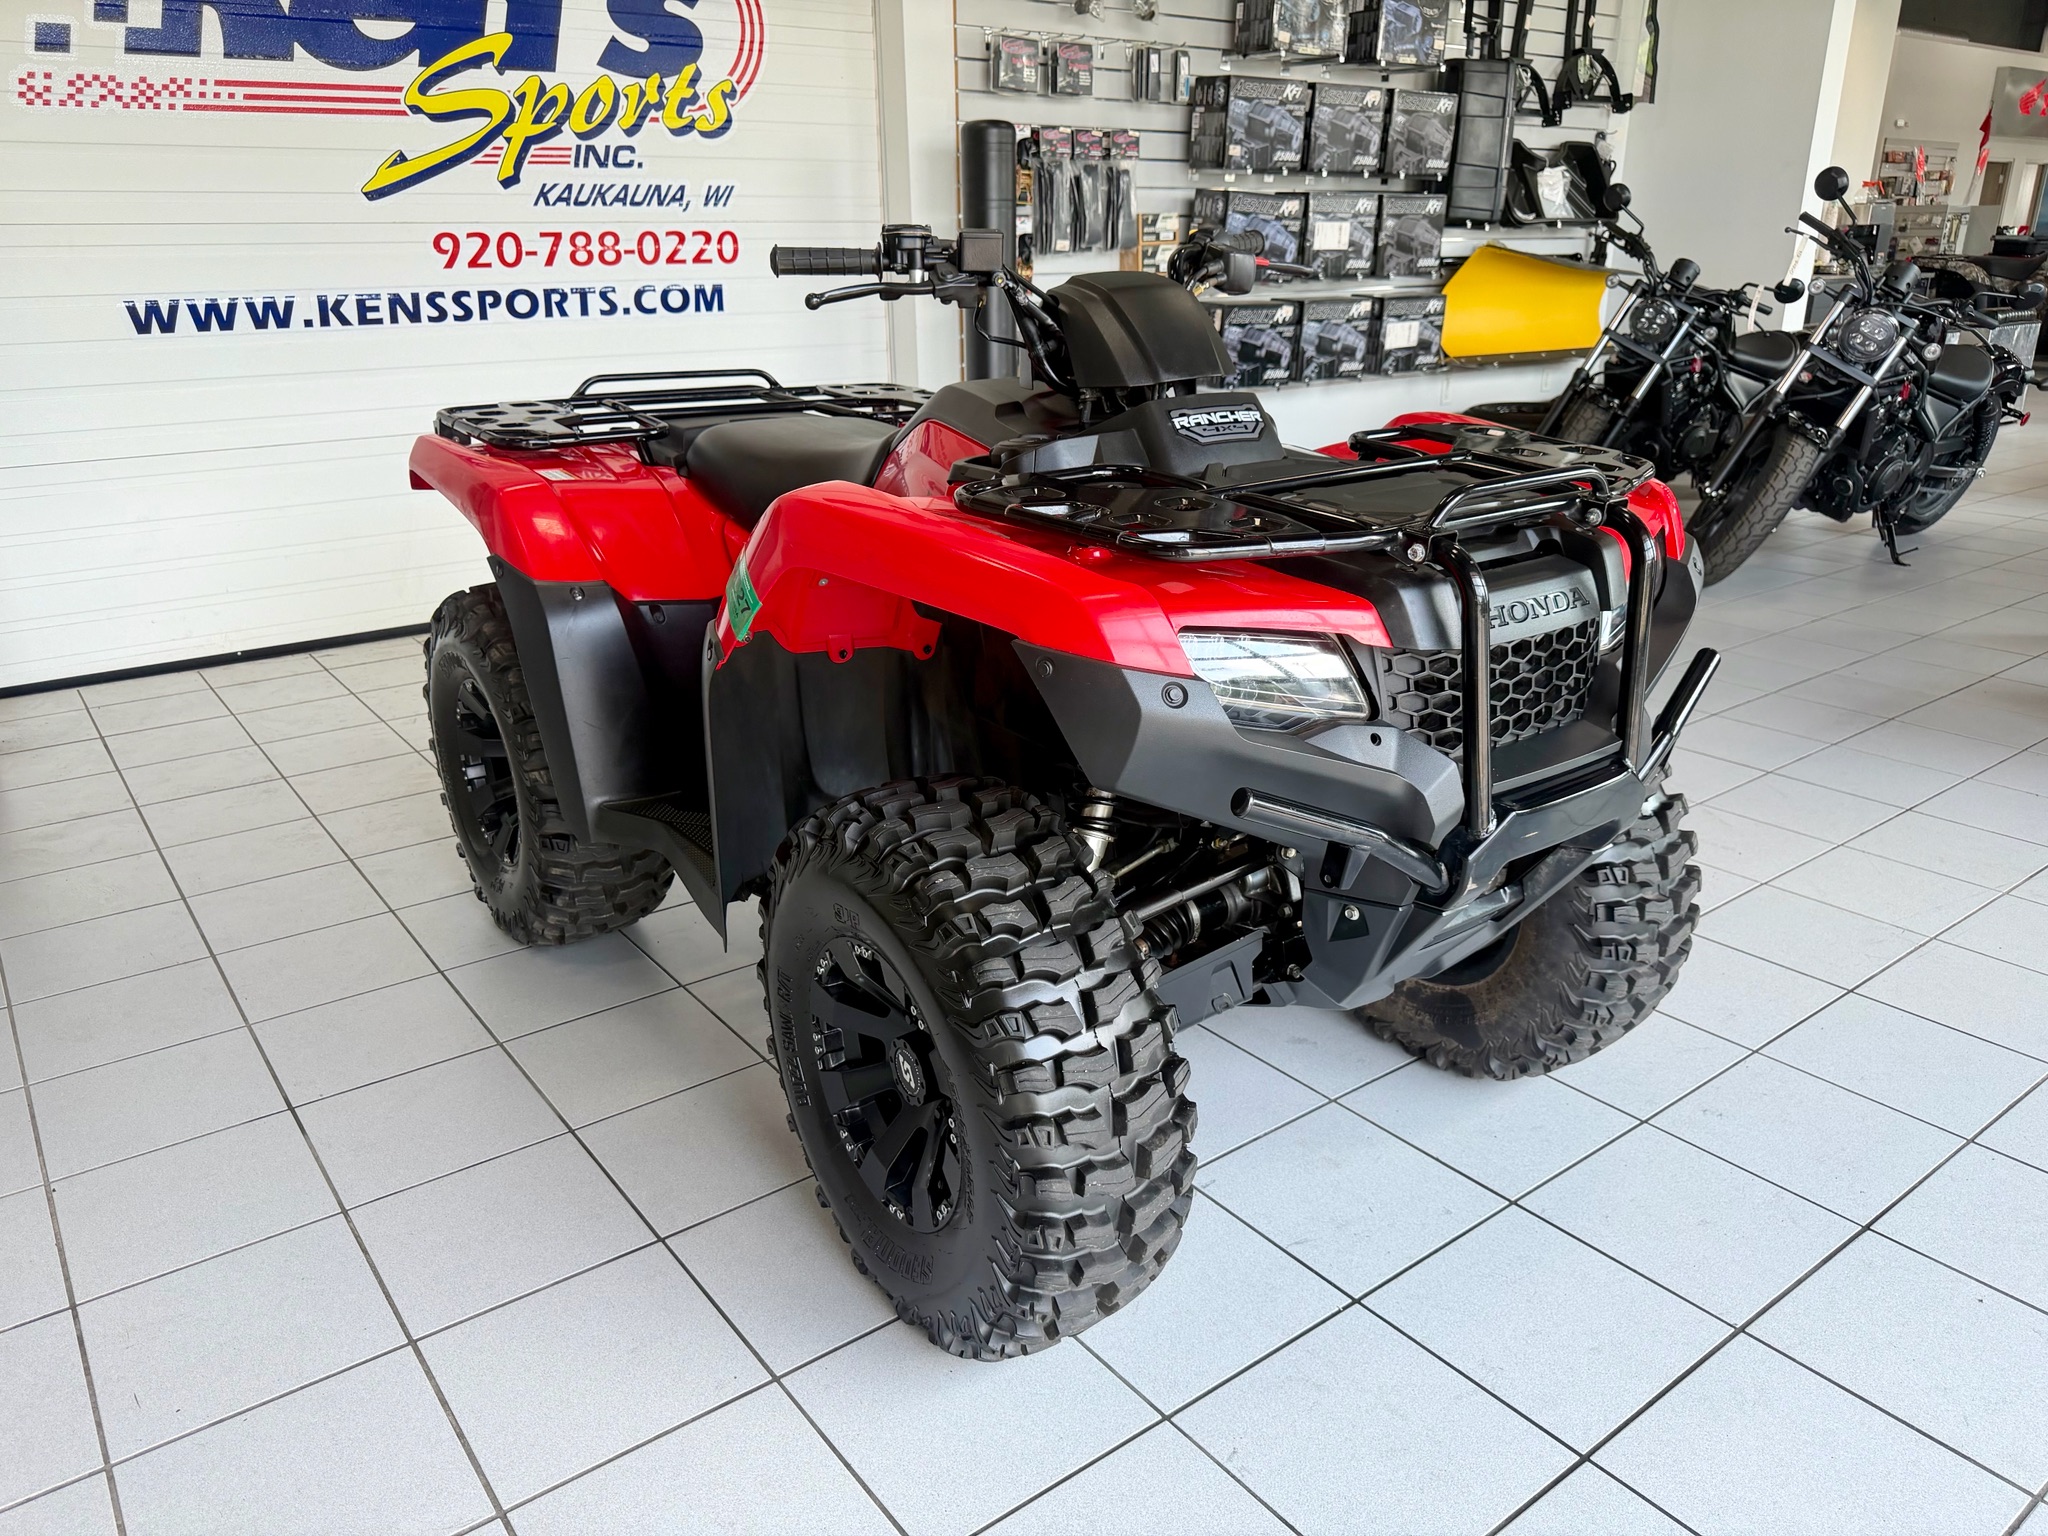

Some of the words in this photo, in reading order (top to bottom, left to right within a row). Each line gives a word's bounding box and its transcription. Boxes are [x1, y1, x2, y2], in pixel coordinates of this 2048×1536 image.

[1231, 79, 1285, 99] ASSAULT
[362, 32, 741, 201] Sports
[572, 144, 643, 169] INC.
[533, 183, 690, 212] KAUKAUNA,
[703, 185, 735, 207] WI
[432, 230, 739, 269] 920-788-0220
[123, 284, 725, 335] WWW.KENSSPORTS.COM
[1172, 410, 1263, 430] RANCHER
